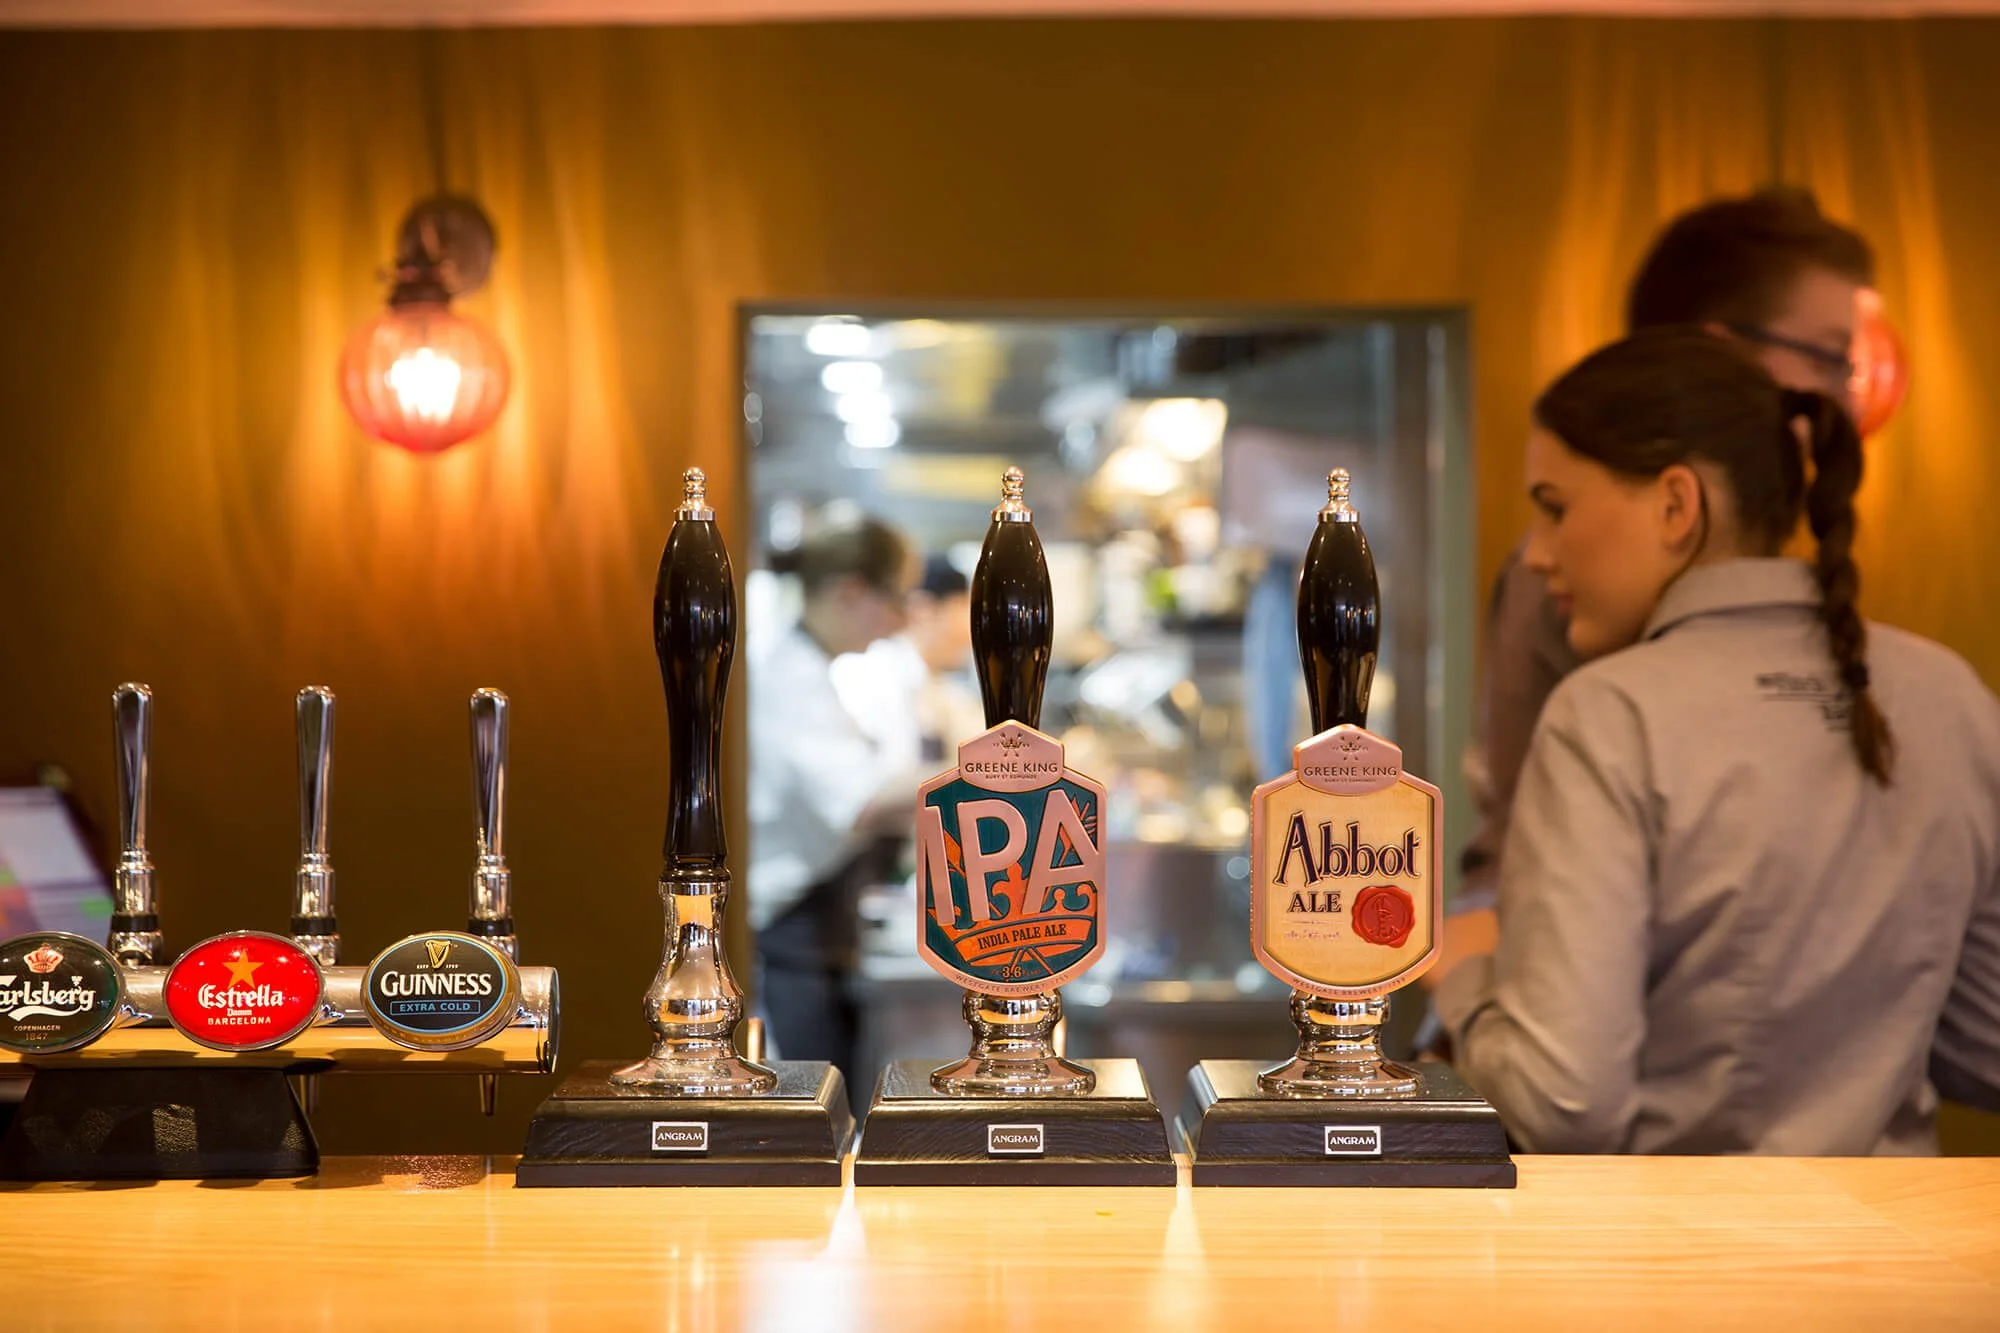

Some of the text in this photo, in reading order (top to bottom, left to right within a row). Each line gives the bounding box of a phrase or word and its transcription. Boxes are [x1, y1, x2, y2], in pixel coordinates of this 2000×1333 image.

[965, 762, 1058, 773] GREENE KING
[1303, 766, 1397, 777] GREENE KING
[1272, 810, 1422, 887] Abbot
[920, 788, 1099, 926] IPA
[1287, 891, 1342, 913] ALE
[977, 923, 1067, 950] INDIA PALE ALE
[380, 971, 492, 997] GUINNESS
[955, 974, 1000, 993] WESTGATE
[1004, 982, 1045, 993] BREWERY
[198, 983, 284, 1009] Estrella
[400, 1002, 471, 1012] EXTRA COLD
[208, 1016, 272, 1025] BARCELONA
[656, 1132, 703, 1141] ANGRAM
[993, 1135, 1039, 1143] ANGRAM
[1329, 1136, 1376, 1145] ANGRAM
